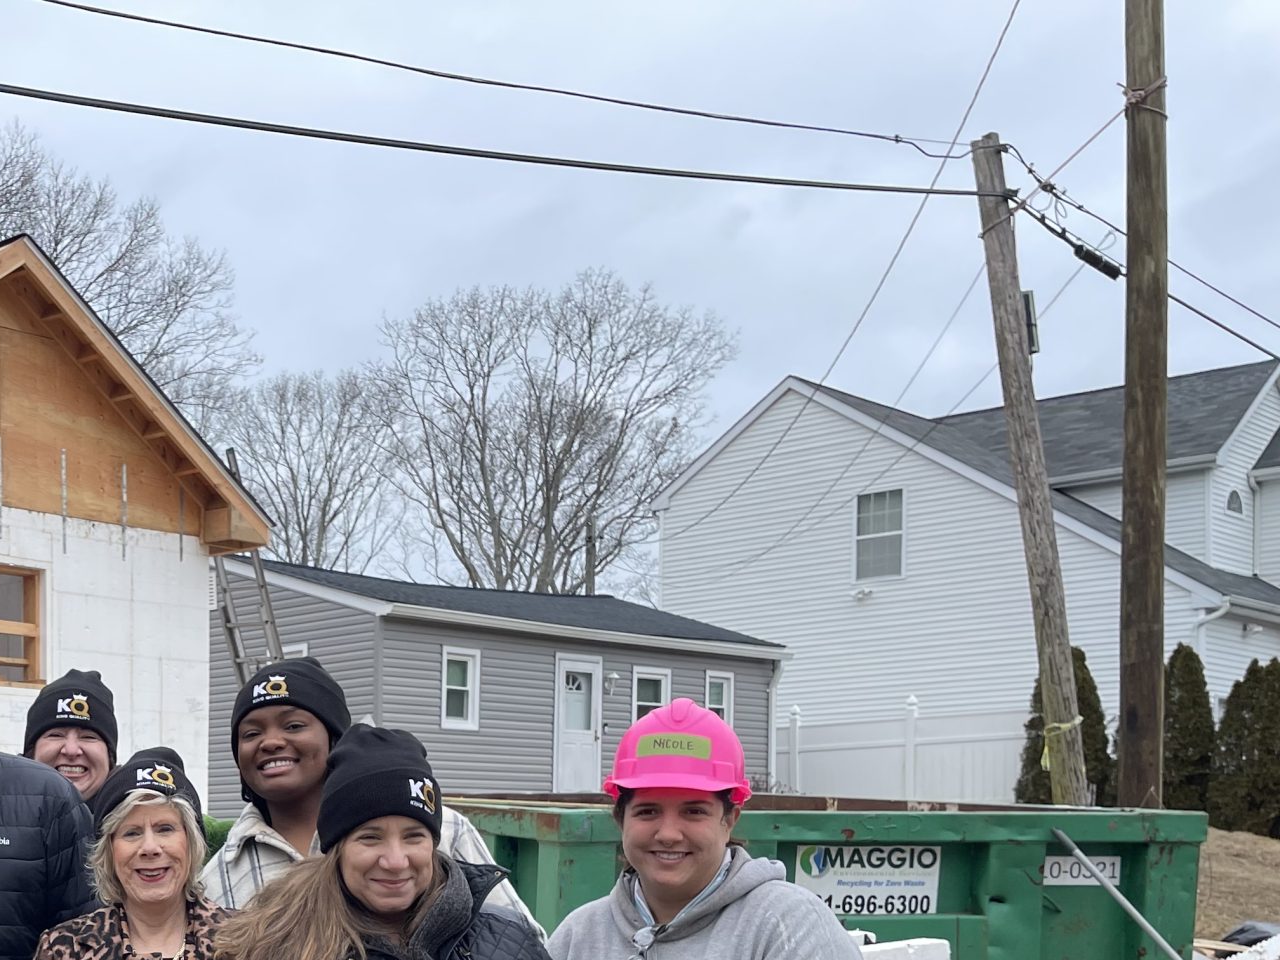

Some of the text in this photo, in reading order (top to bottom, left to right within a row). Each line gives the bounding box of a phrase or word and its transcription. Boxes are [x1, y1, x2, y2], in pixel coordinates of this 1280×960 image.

[252, 680, 289, 697] KQ
[57, 698, 90, 717] KQ
[653, 738, 694, 750] NICOLE
[136, 768, 176, 790] KQ
[409, 779, 436, 813] KQ
[822, 847, 937, 869] MAGGIO
[837, 879, 871, 888] Recycling
